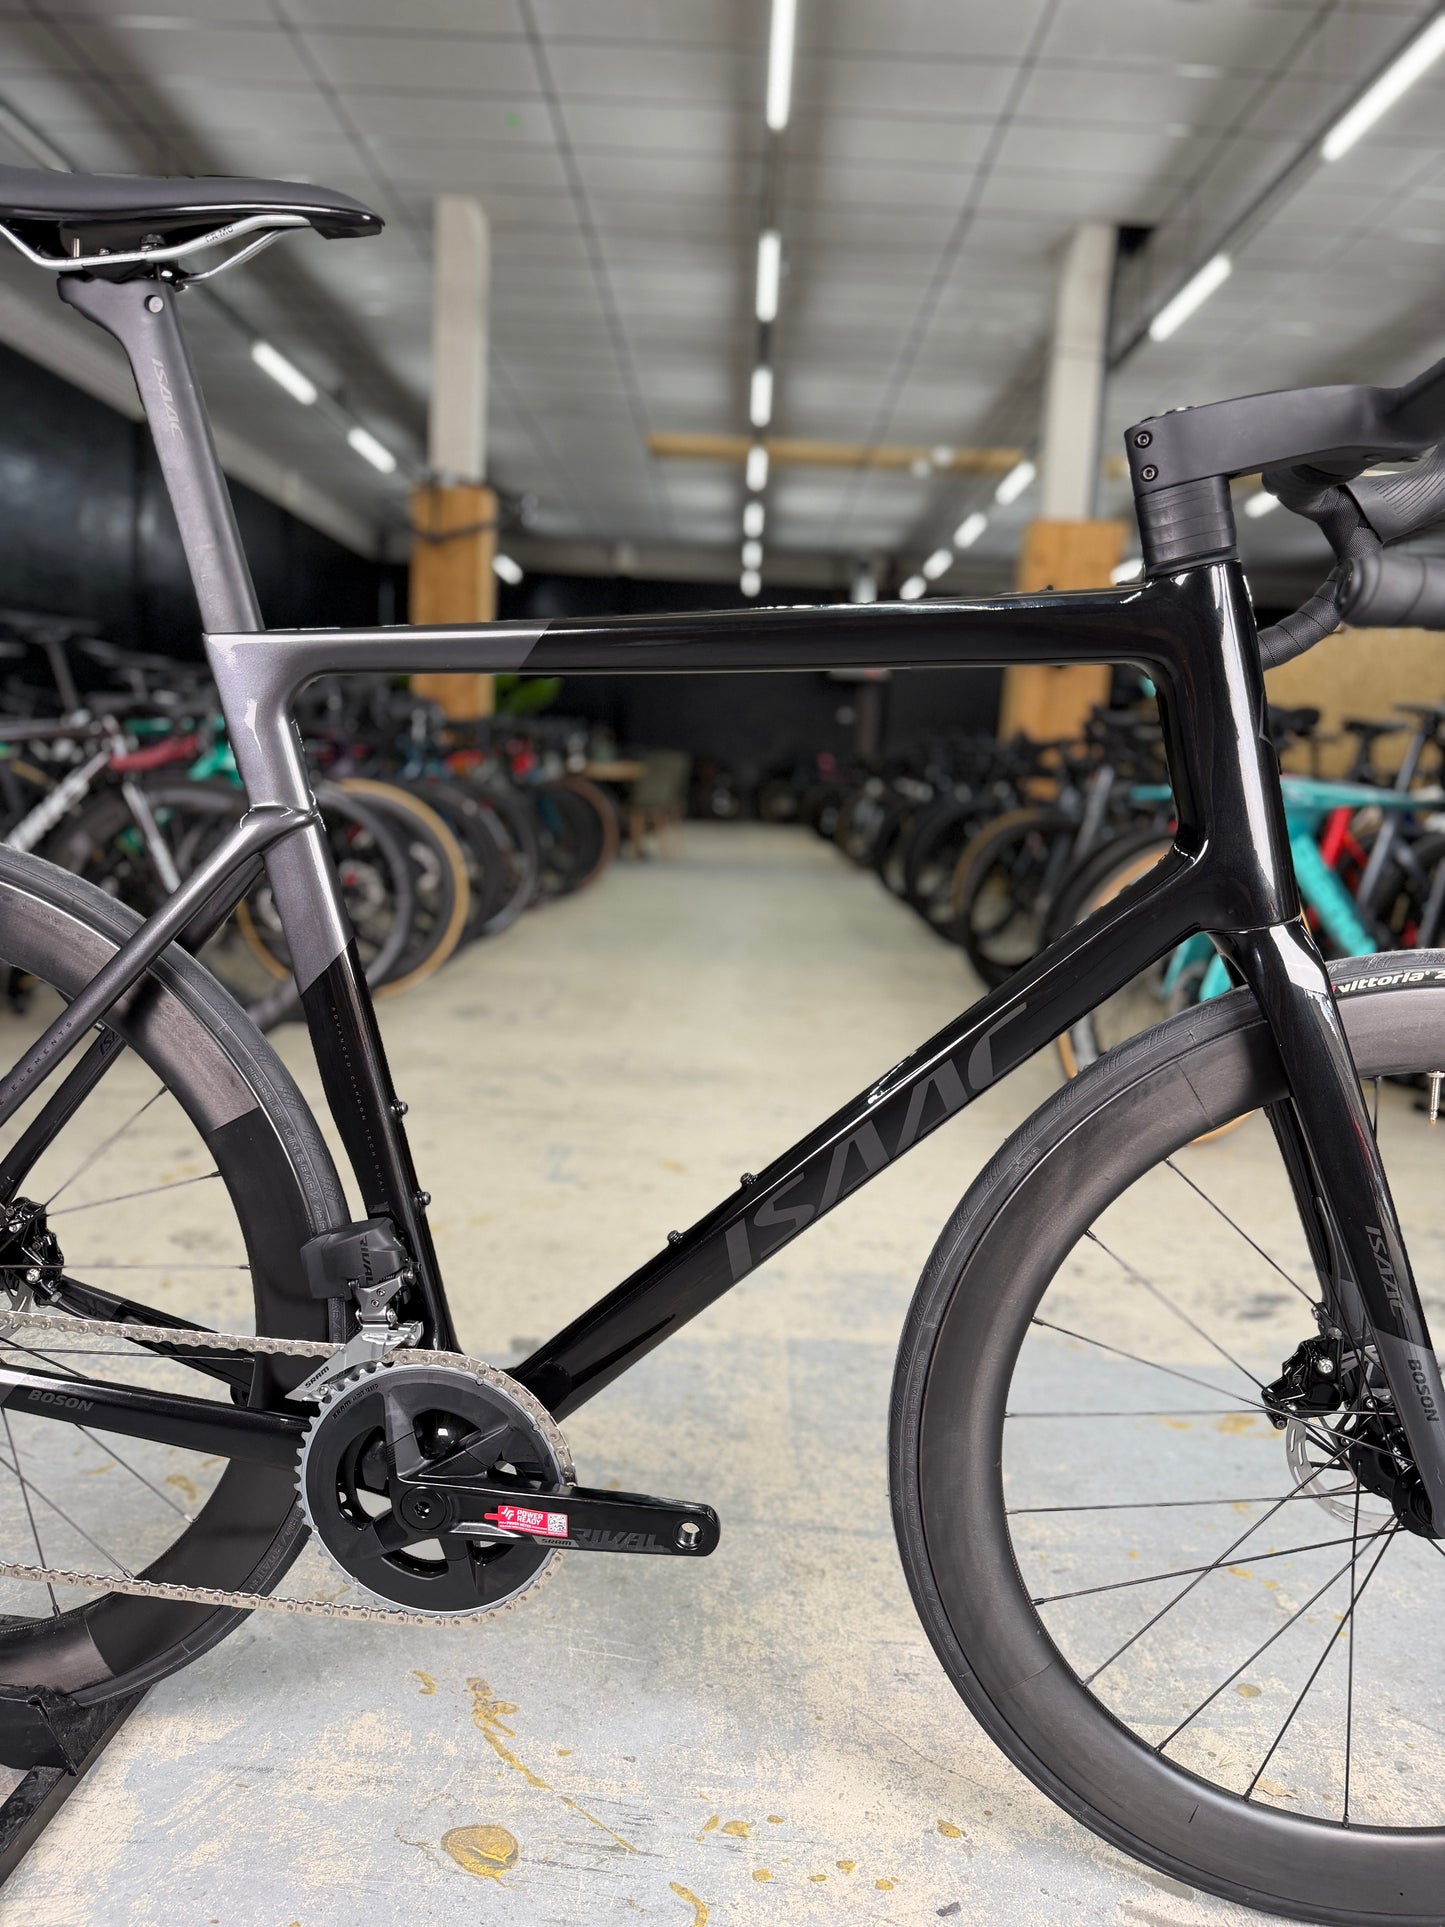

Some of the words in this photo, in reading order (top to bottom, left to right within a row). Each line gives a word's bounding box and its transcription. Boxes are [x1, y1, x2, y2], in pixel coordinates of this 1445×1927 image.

[151, 358, 184, 441] ISAAC
[10, 1021, 73, 1092] ELEMENTS
[724, 1001, 1028, 1281] ISAAC
[359, 1234, 375, 1284] RIVAL
[1364, 1224, 1408, 1318] ISAAC
[28, 1389, 96, 1412] BOSON
[304, 1366, 330, 1389] SRAM
[1407, 1358, 1440, 1423] BOSON
[516, 1509, 544, 1521] POWER
[516, 1515, 542, 1526] READY
[542, 1538, 572, 1546] SRAM
